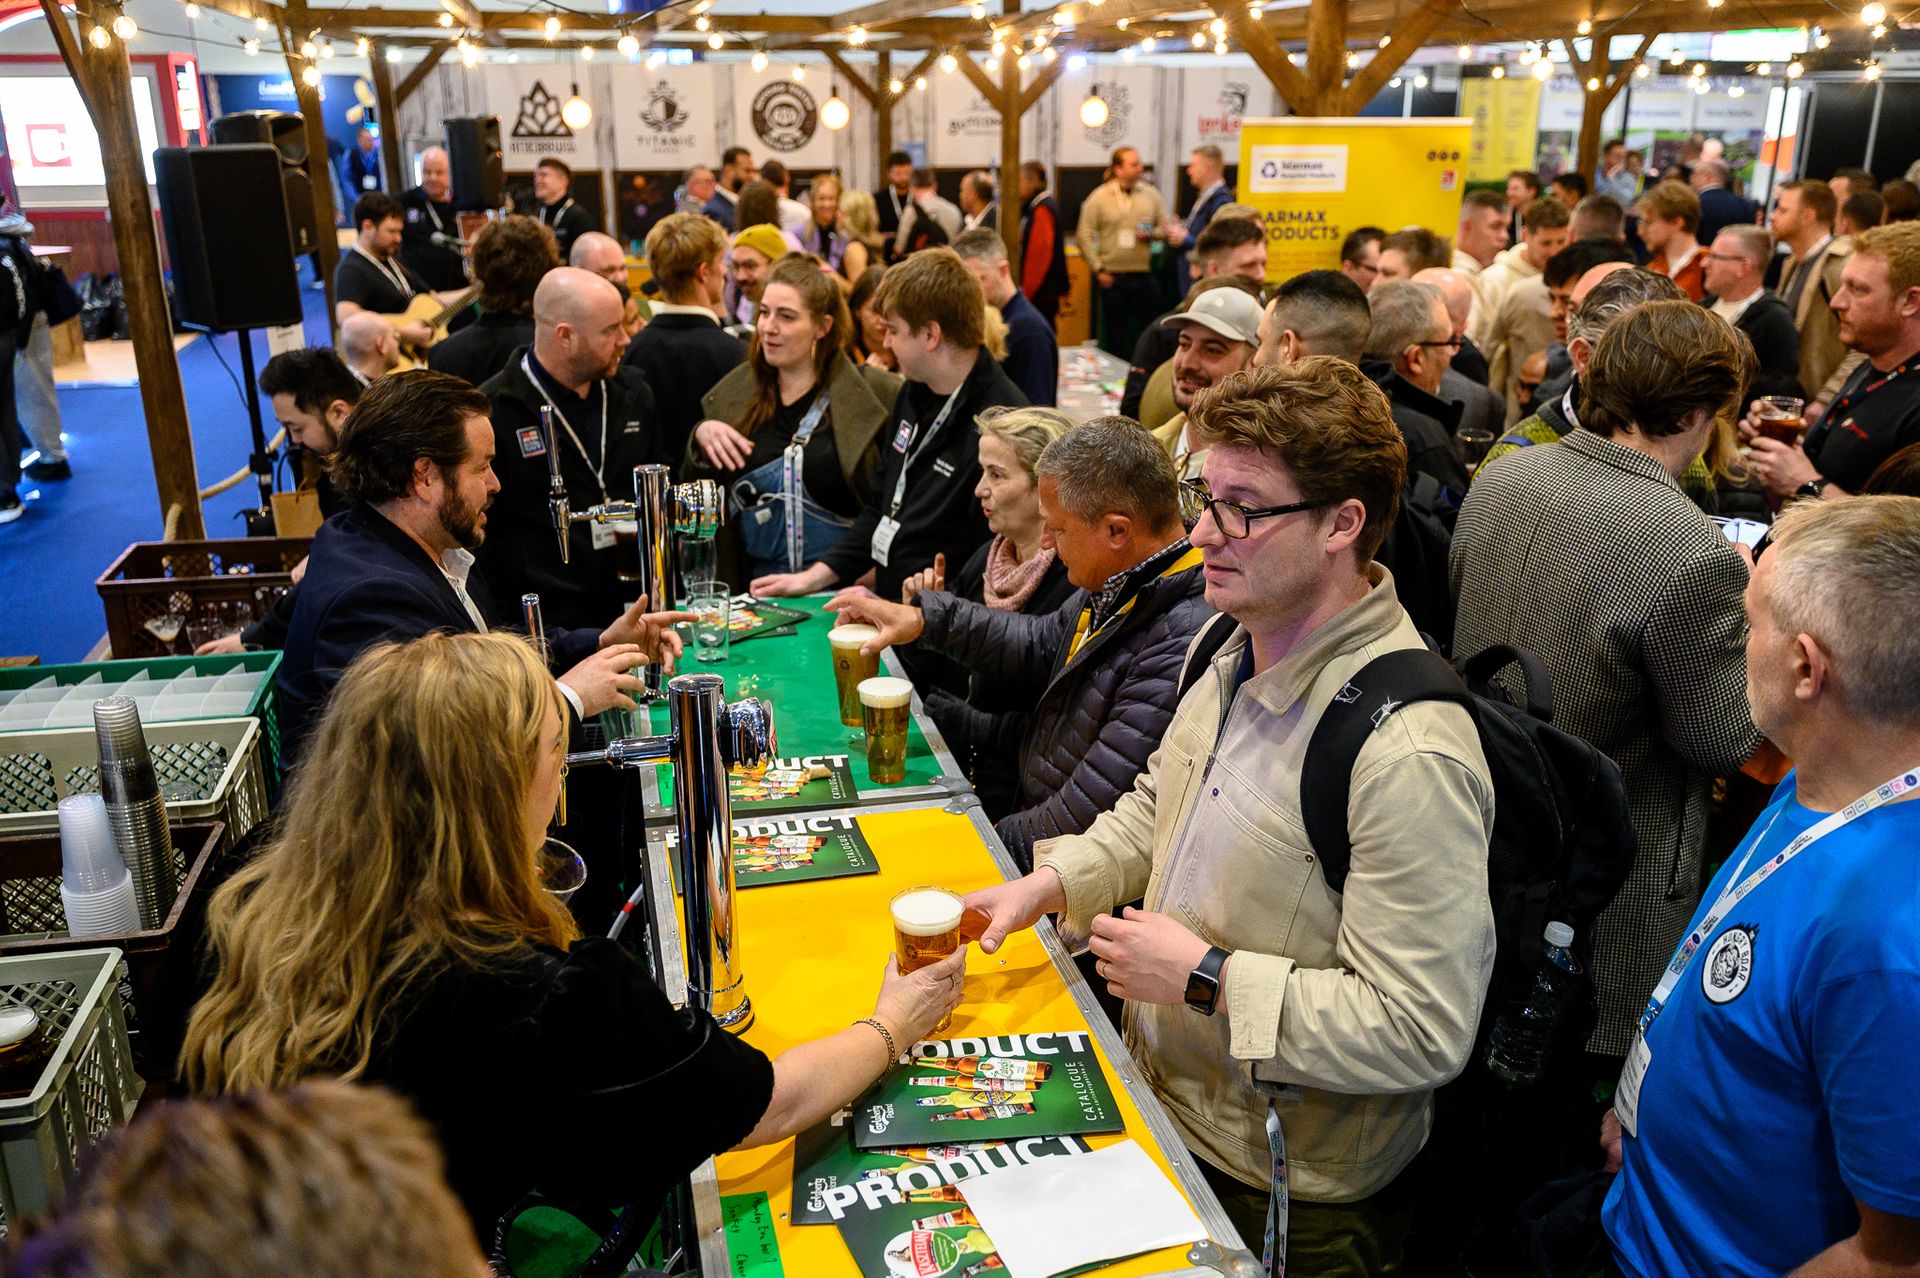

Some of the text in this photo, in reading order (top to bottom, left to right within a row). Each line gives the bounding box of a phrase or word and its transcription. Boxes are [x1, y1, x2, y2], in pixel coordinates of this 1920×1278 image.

[1723, 930, 1749, 981] HUNGRY BOAR
[1065, 1061, 1097, 1121] CATALOGUE
[866, 1105, 889, 1134] Carlsberg
